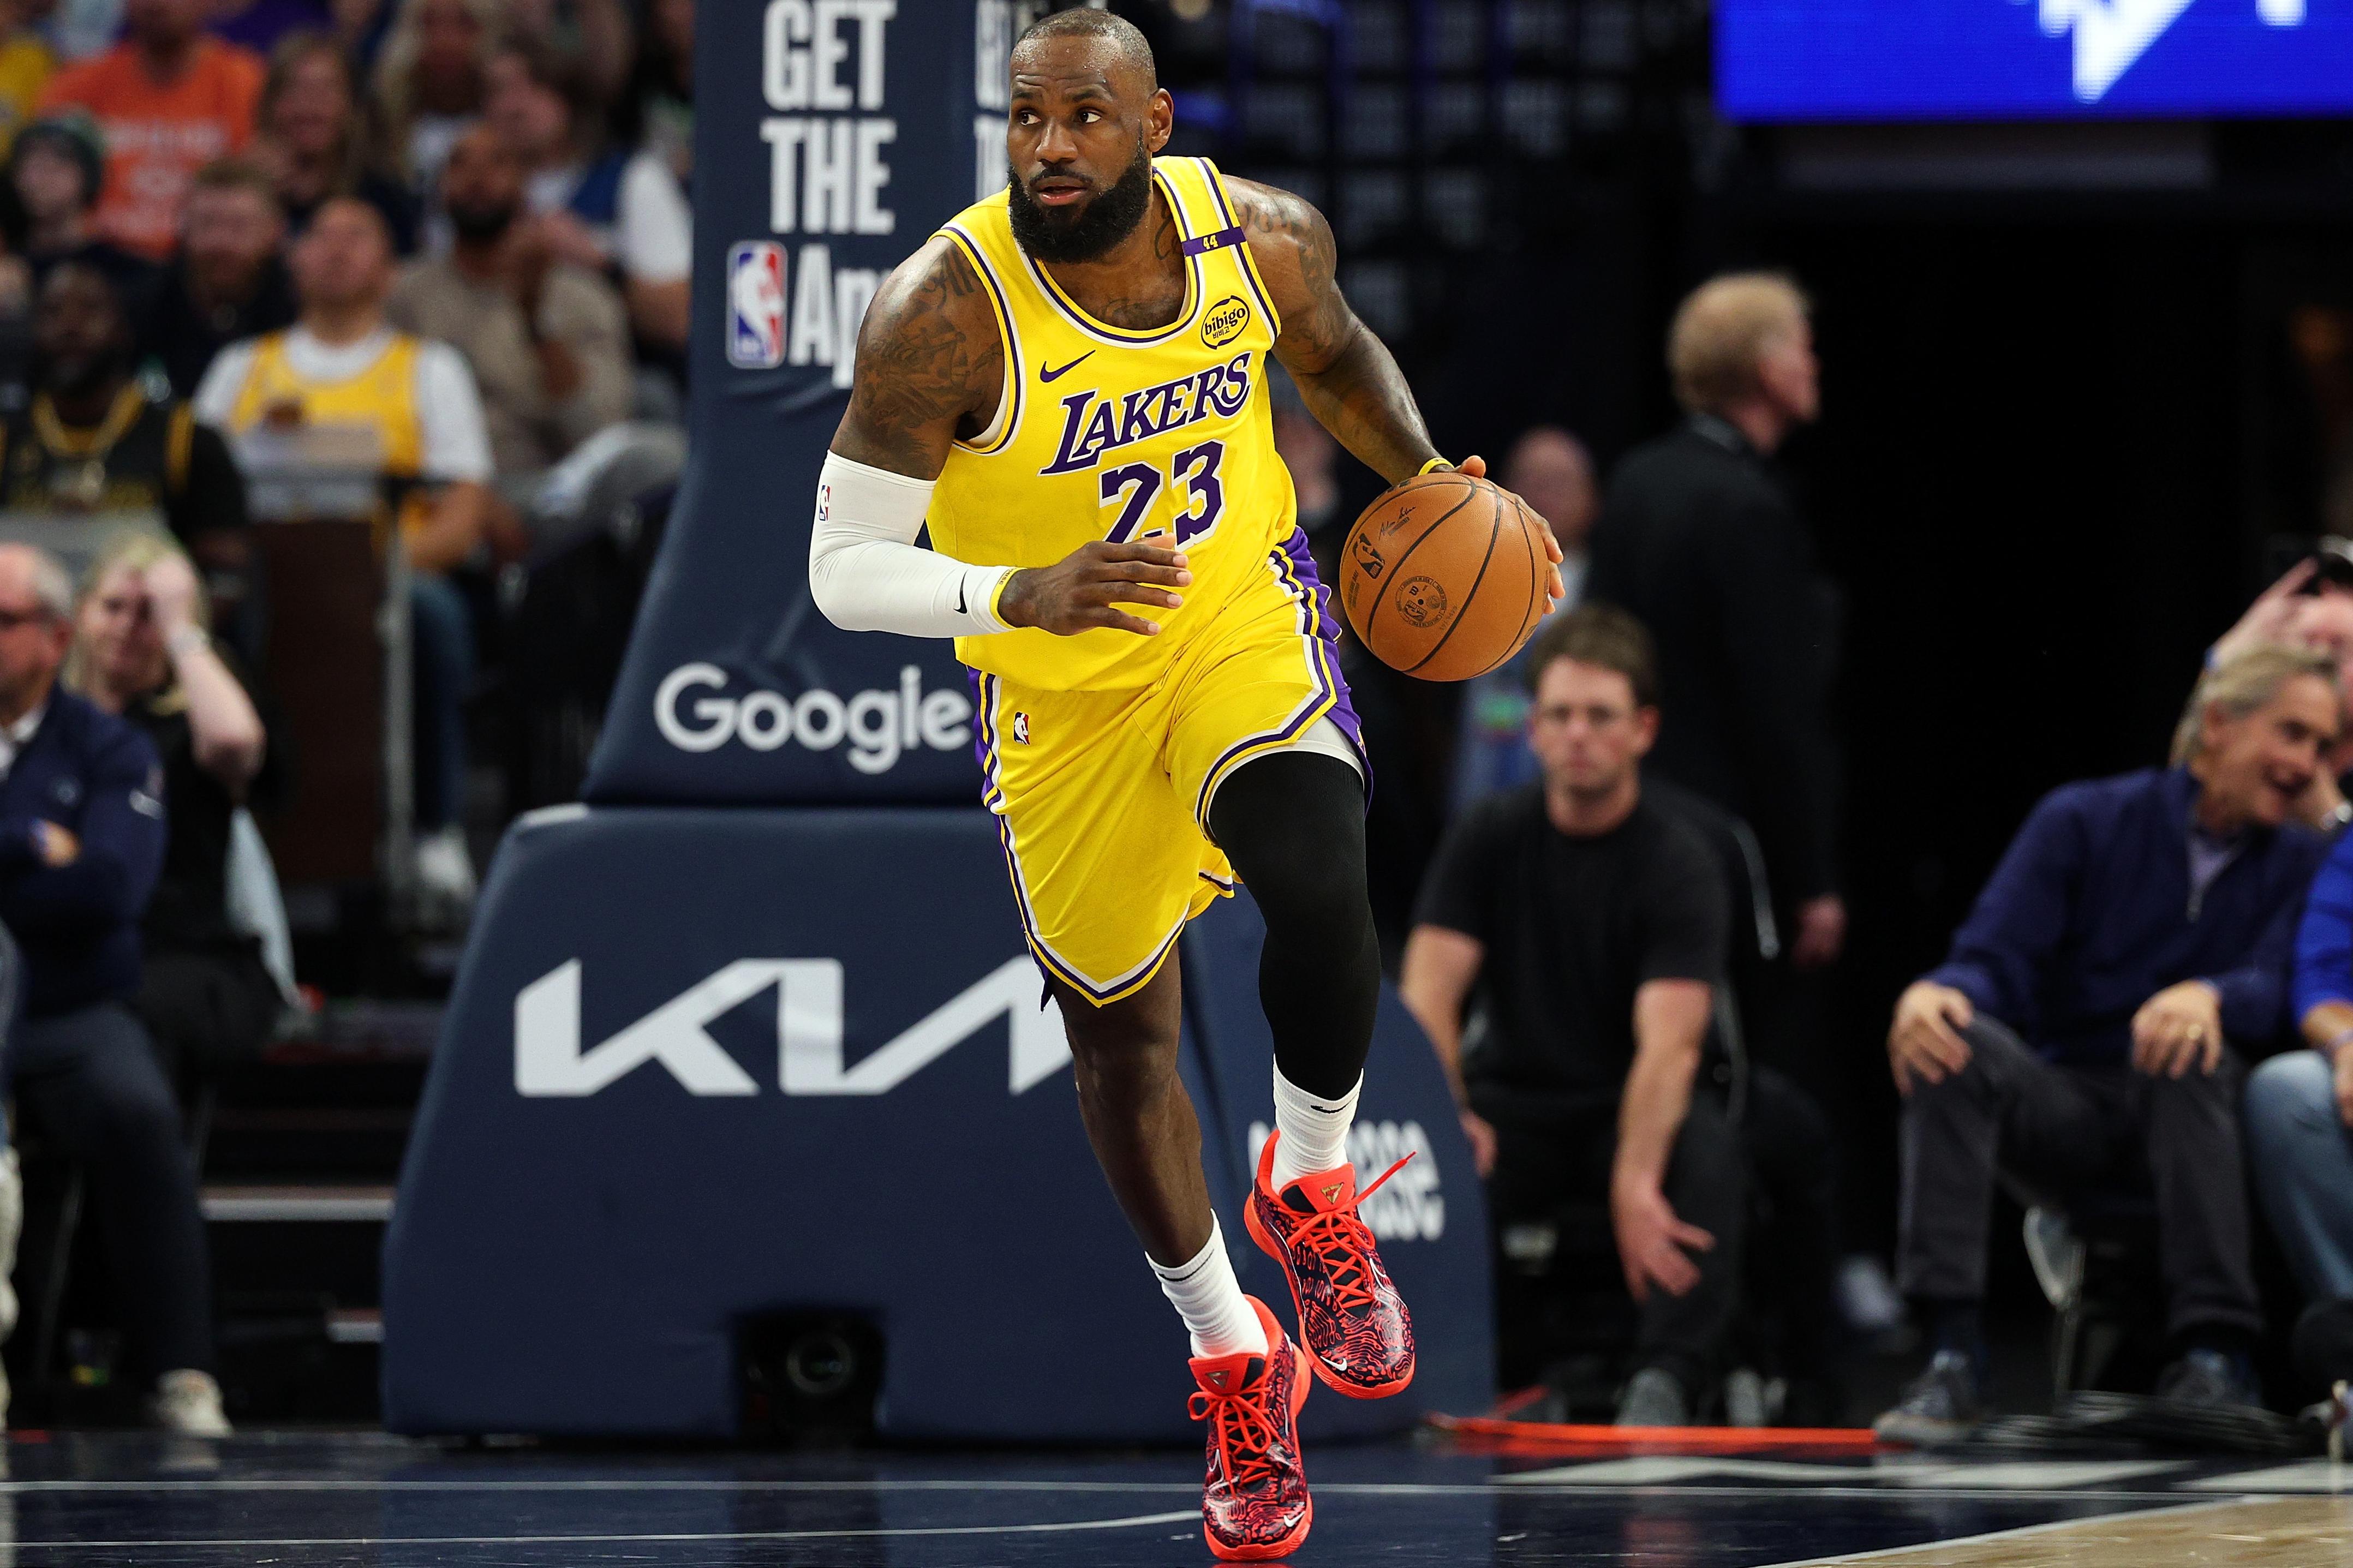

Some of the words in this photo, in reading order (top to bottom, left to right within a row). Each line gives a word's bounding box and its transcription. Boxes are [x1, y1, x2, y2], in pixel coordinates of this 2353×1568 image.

[763, 0, 897, 111] GET
[760, 117, 897, 235] THE
[1203, 235, 1219, 249] 44
[790, 243, 895, 389] Ap
[1205, 307, 1246, 336] bibigo
[1213, 326, 1230, 339] 비비고
[1038, 351, 1253, 476] LAKERS
[1098, 439, 1227, 552] 23
[656, 662, 973, 774] Google
[515, 957, 1075, 1097] KIA
